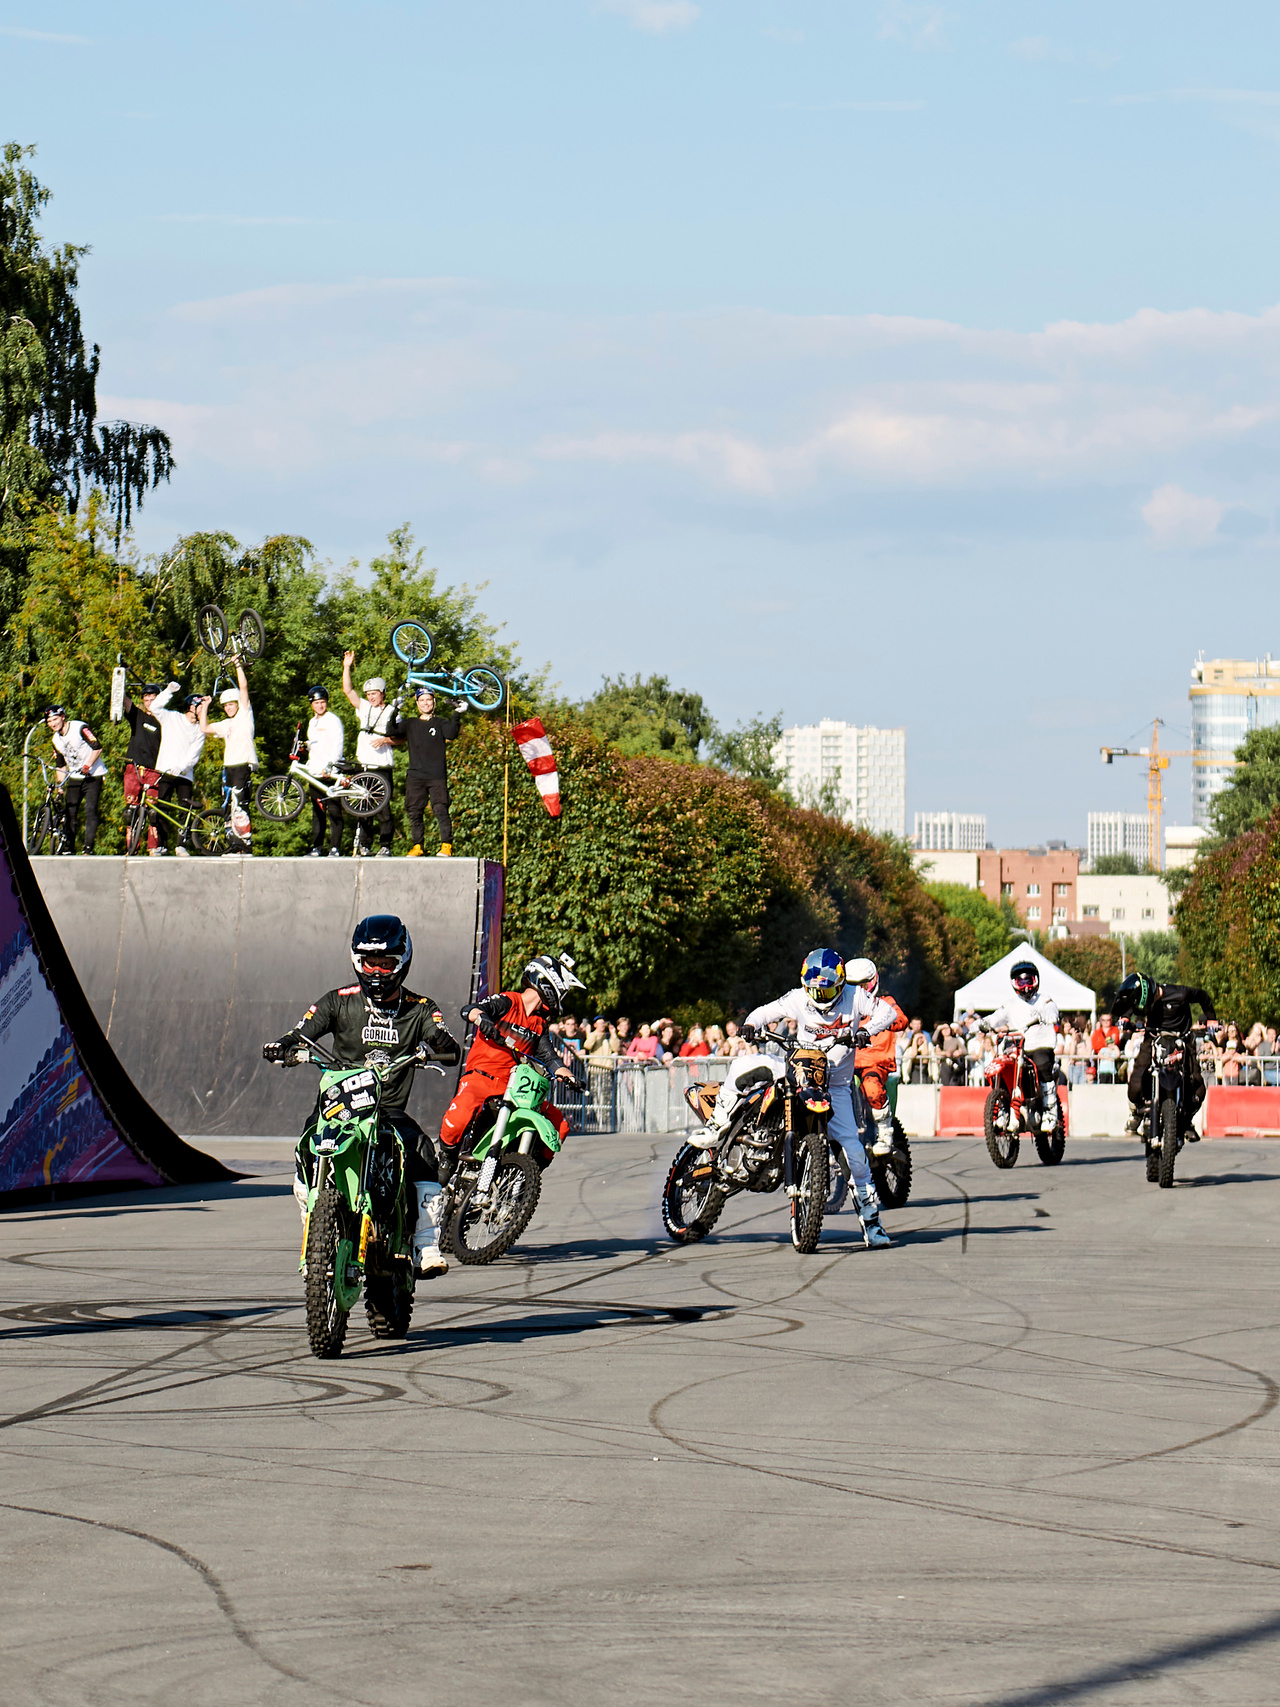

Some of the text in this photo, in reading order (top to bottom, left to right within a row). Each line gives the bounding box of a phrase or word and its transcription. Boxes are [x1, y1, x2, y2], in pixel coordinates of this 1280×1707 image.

[364, 1028, 397, 1042] GORILLA
[341, 1070, 374, 1094] 102
[517, 1076, 548, 1102] 247
